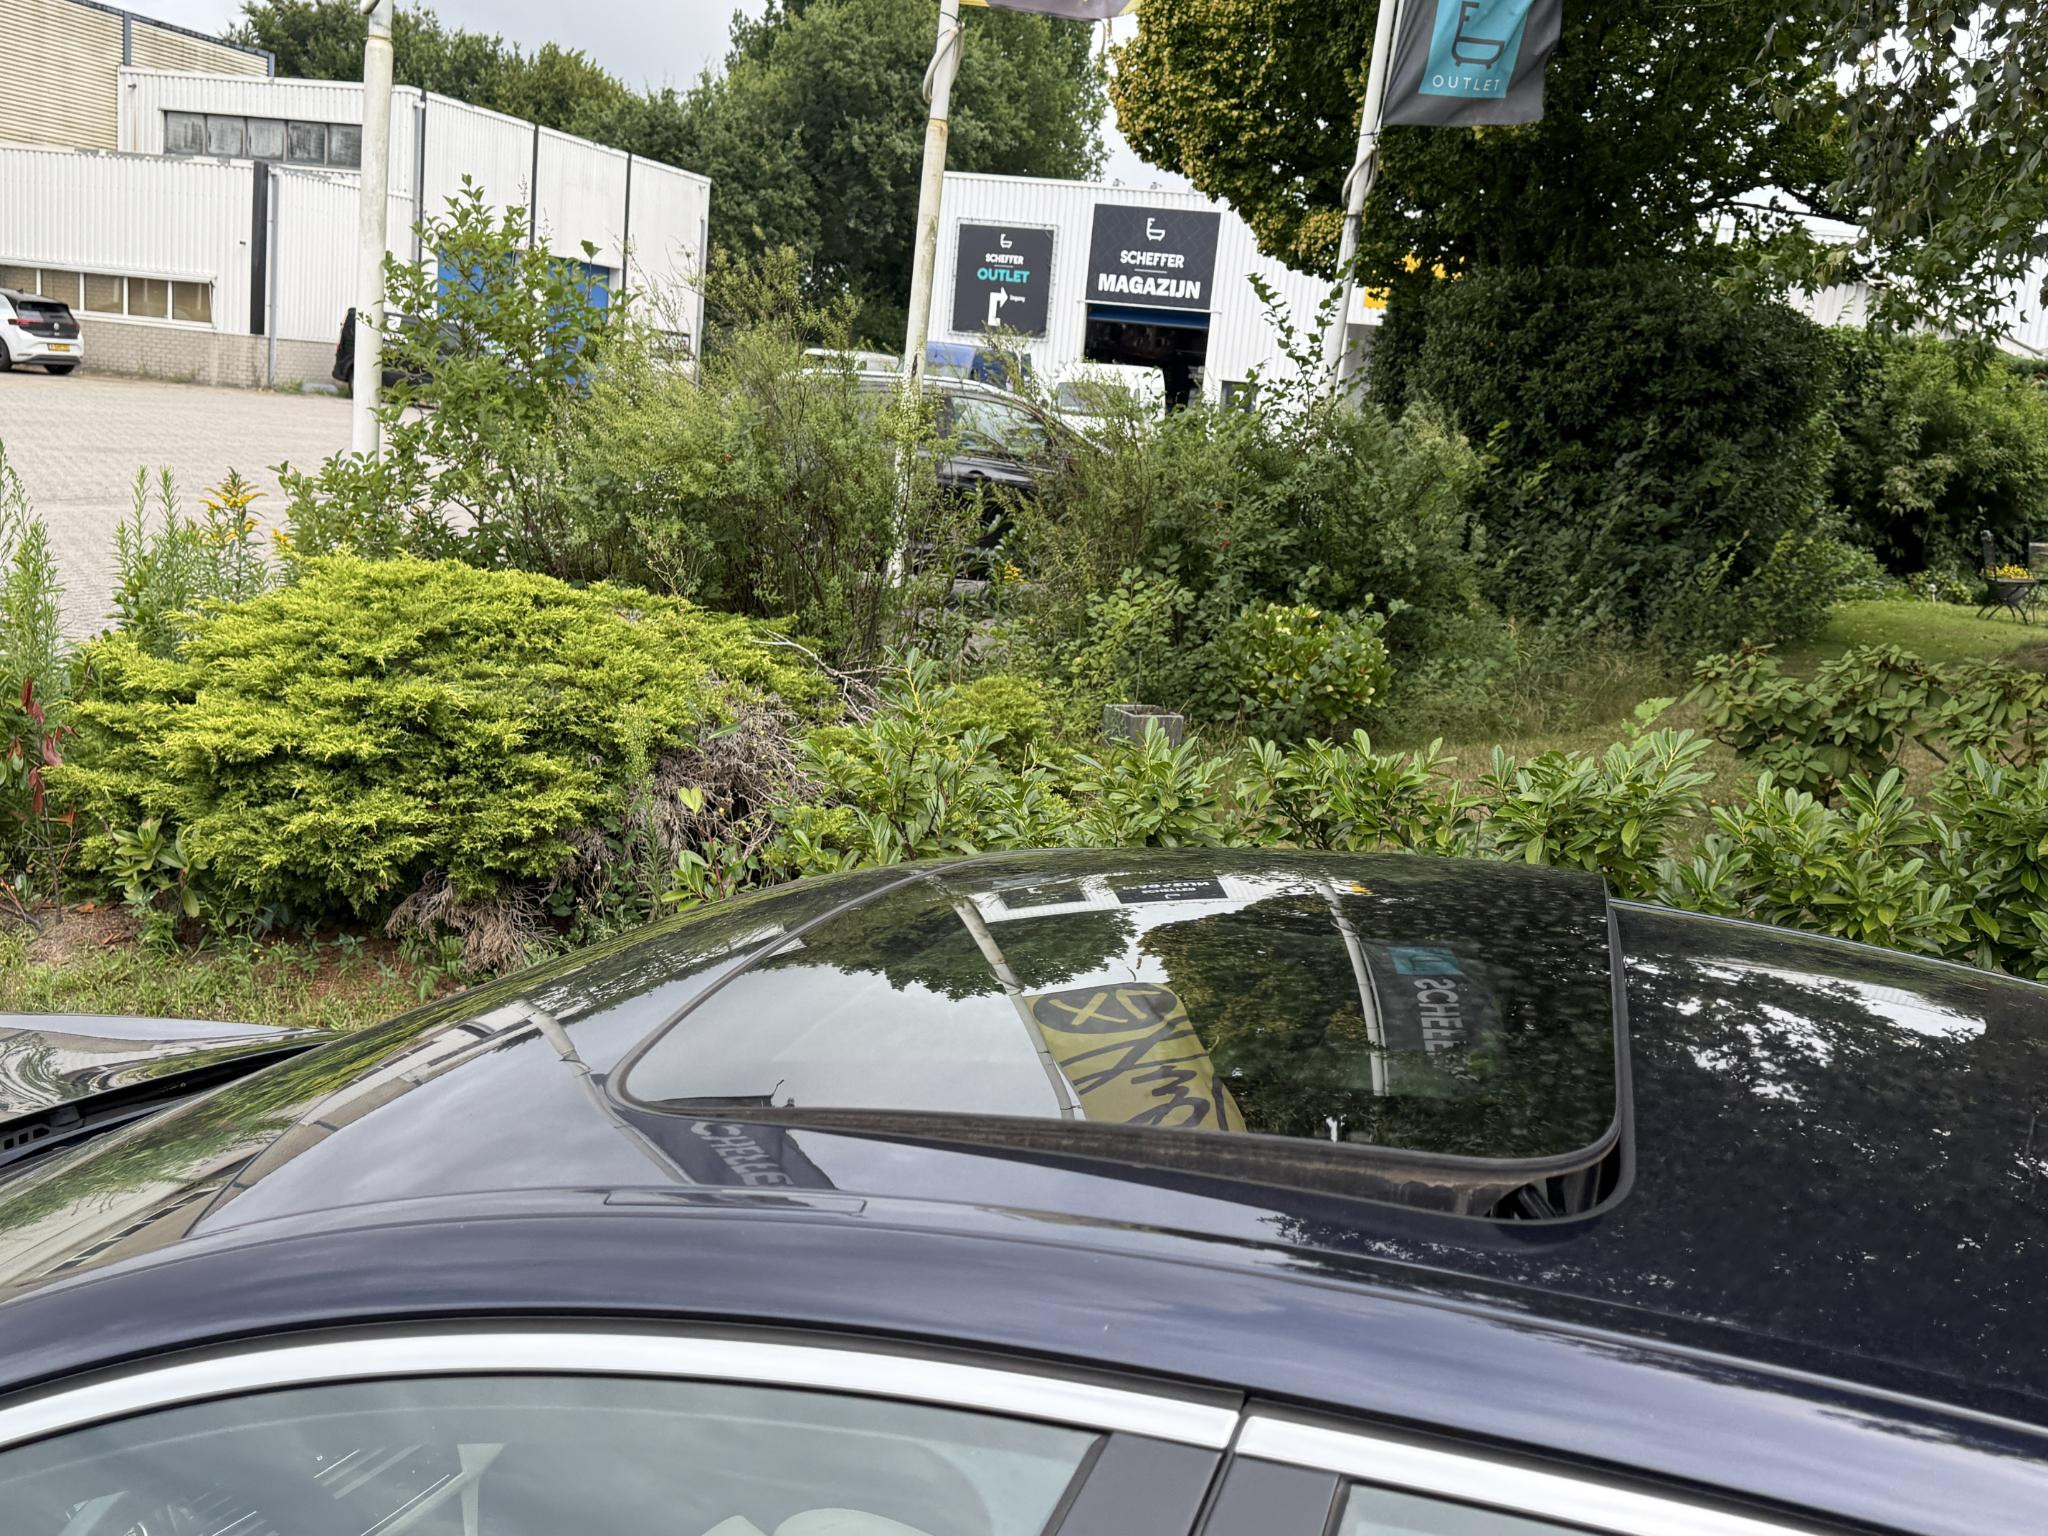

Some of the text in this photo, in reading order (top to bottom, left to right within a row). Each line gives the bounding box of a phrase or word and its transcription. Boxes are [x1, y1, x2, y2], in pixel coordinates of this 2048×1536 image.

[1432, 74, 1500, 92] OUTLET
[985, 253, 1024, 265] SCHEFFER
[1120, 250, 1185, 268] SCHEFFER
[977, 267, 1030, 284] OUTLET
[1098, 273, 1201, 299] MAGAZIJN
